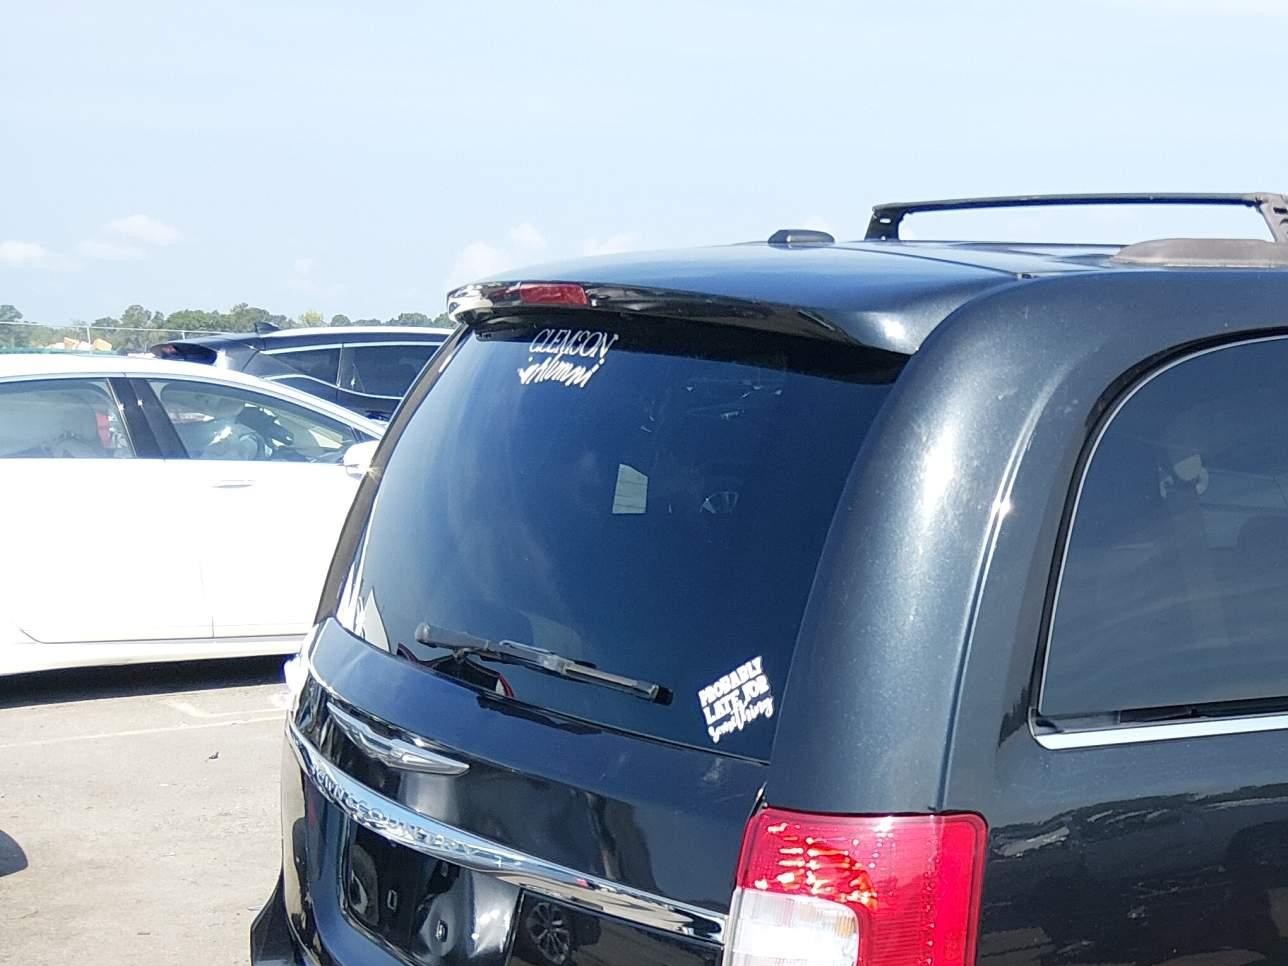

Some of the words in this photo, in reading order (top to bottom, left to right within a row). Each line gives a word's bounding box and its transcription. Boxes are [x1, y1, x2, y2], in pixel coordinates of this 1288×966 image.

[529, 328, 619, 358] CLEMSON
[697, 655, 764, 709] PROBABLY
[702, 688, 742, 726] LATE
